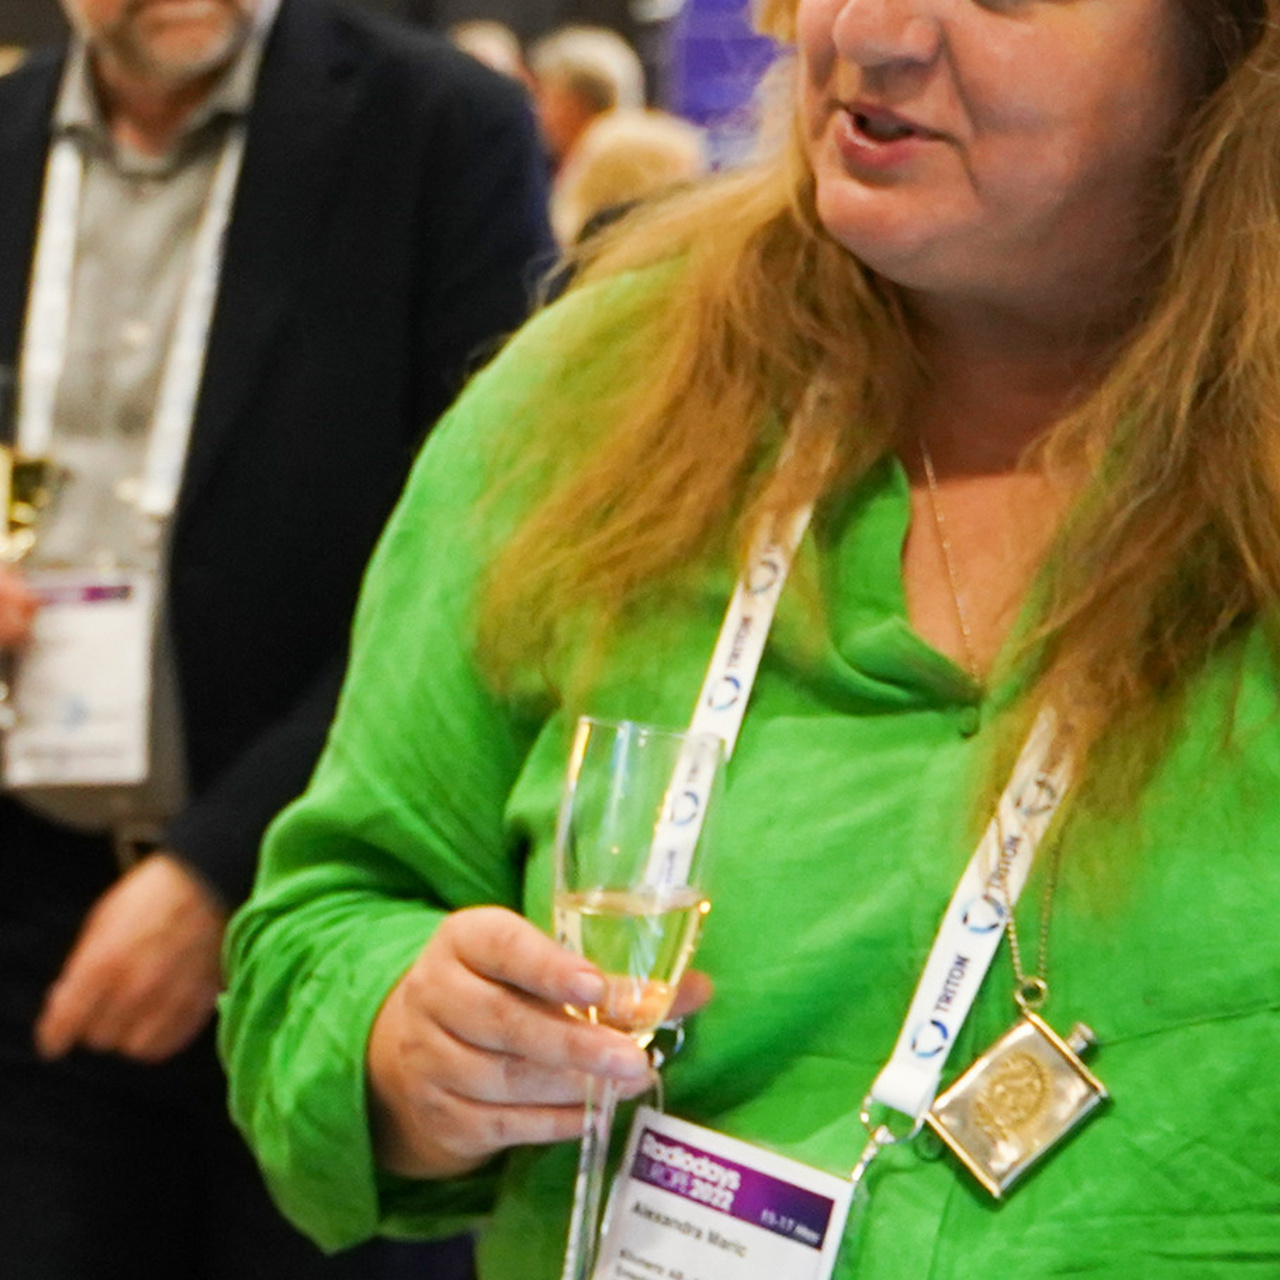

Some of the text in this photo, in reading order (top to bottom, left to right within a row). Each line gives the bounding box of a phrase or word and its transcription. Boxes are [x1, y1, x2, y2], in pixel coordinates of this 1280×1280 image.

[934, 955, 971, 1014] TRITON
[641, 1132, 741, 1192] Radiodays
[689, 1177, 736, 1211] 2022
